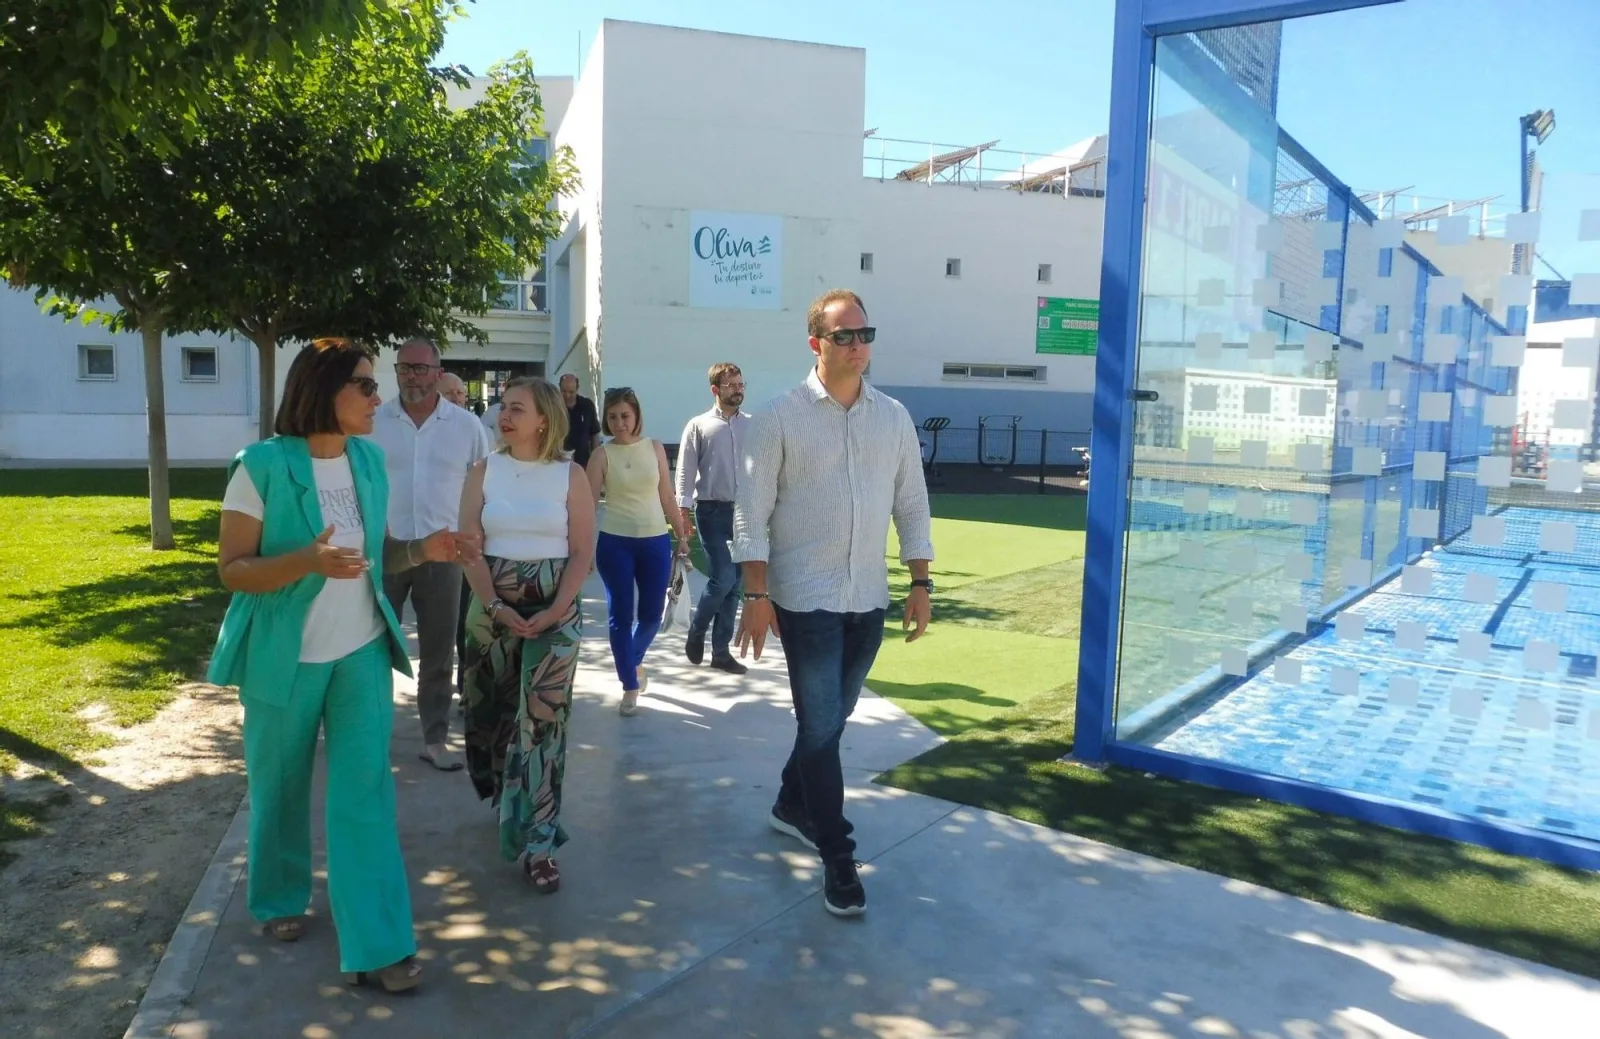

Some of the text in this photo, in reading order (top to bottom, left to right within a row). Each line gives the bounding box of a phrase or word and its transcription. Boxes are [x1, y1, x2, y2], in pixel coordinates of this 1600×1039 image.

[694, 226, 756, 260] Oliva
[716, 260, 761, 274] Tu destino
[714, 274, 723, 284] tu
